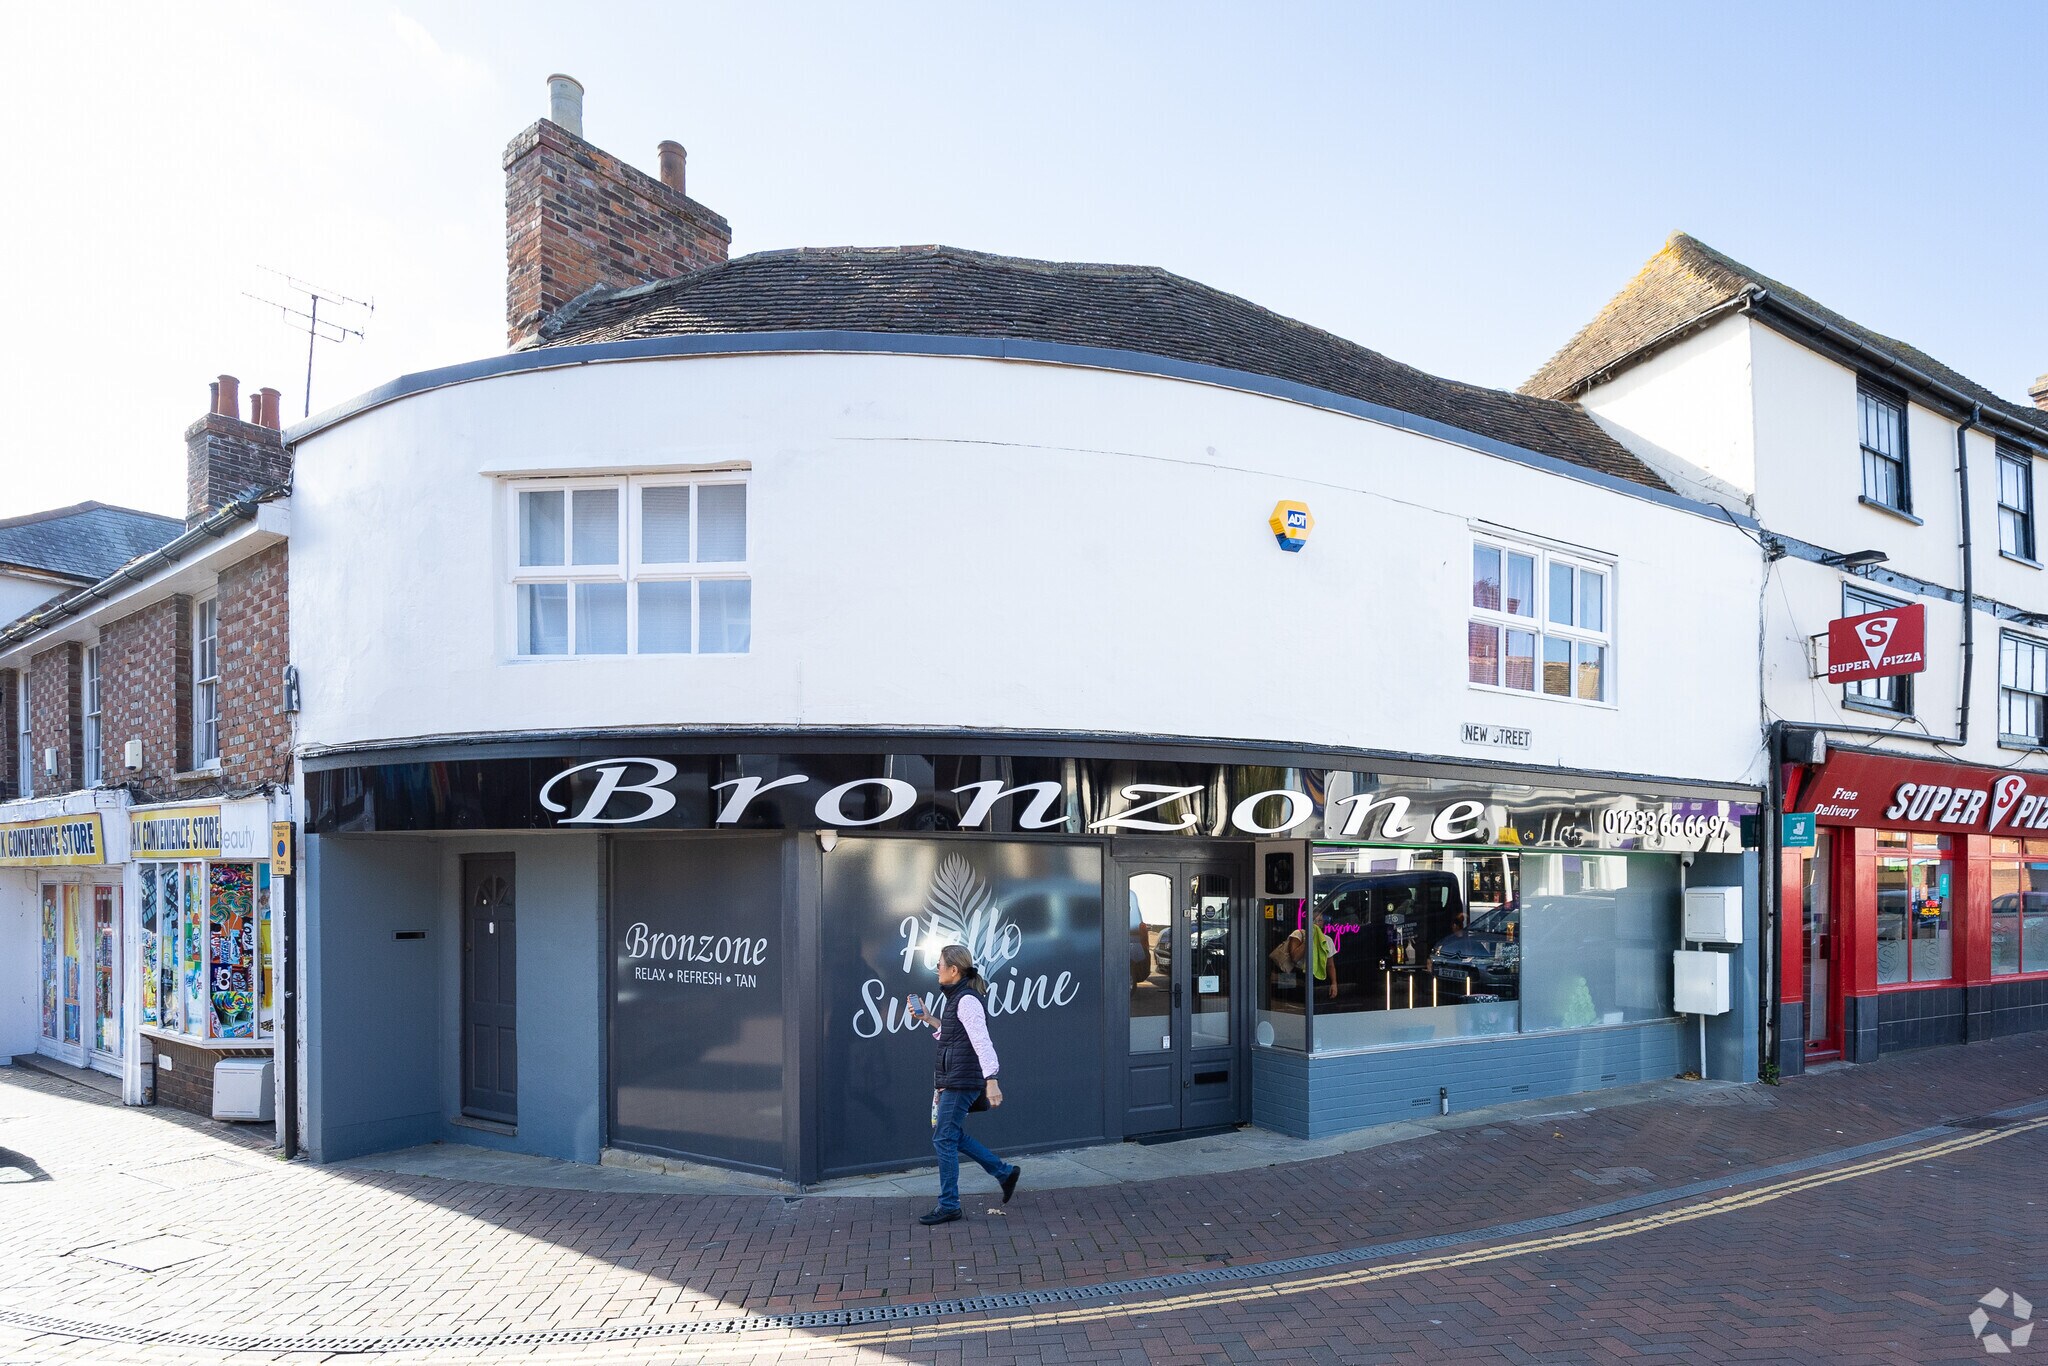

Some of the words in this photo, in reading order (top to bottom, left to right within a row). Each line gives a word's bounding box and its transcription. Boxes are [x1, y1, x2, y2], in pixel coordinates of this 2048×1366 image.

[1287, 513, 1307, 527] ADT
[1865, 620, 1888, 647] S
[1829, 659, 1871, 674] SUPER
[1882, 651, 1922, 666] PIZZA
[1465, 725, 1488, 742] NEW
[539, 757, 1485, 841] Bronzone
[1832, 787, 1859, 801] Free
[1886, 782, 1989, 825] SUPER
[1997, 778, 2020, 809] S
[1814, 803, 1859, 820] Delivery
[0, 830, 6, 857] K
[8, 825, 60, 857] CONVENIENCE
[61, 822, 95, 856] STORE
[142, 818, 190, 850] CONVENIENCE
[193, 816, 219, 849] STORE
[221, 825, 255, 853] eauty
[625, 922, 768, 966] Bronzone
[635, 967, 666, 982] RELAX
[677, 969, 722, 985] REFRESH
[735, 973, 757, 988] TAN
[853, 964, 1080, 1038] Sunine
